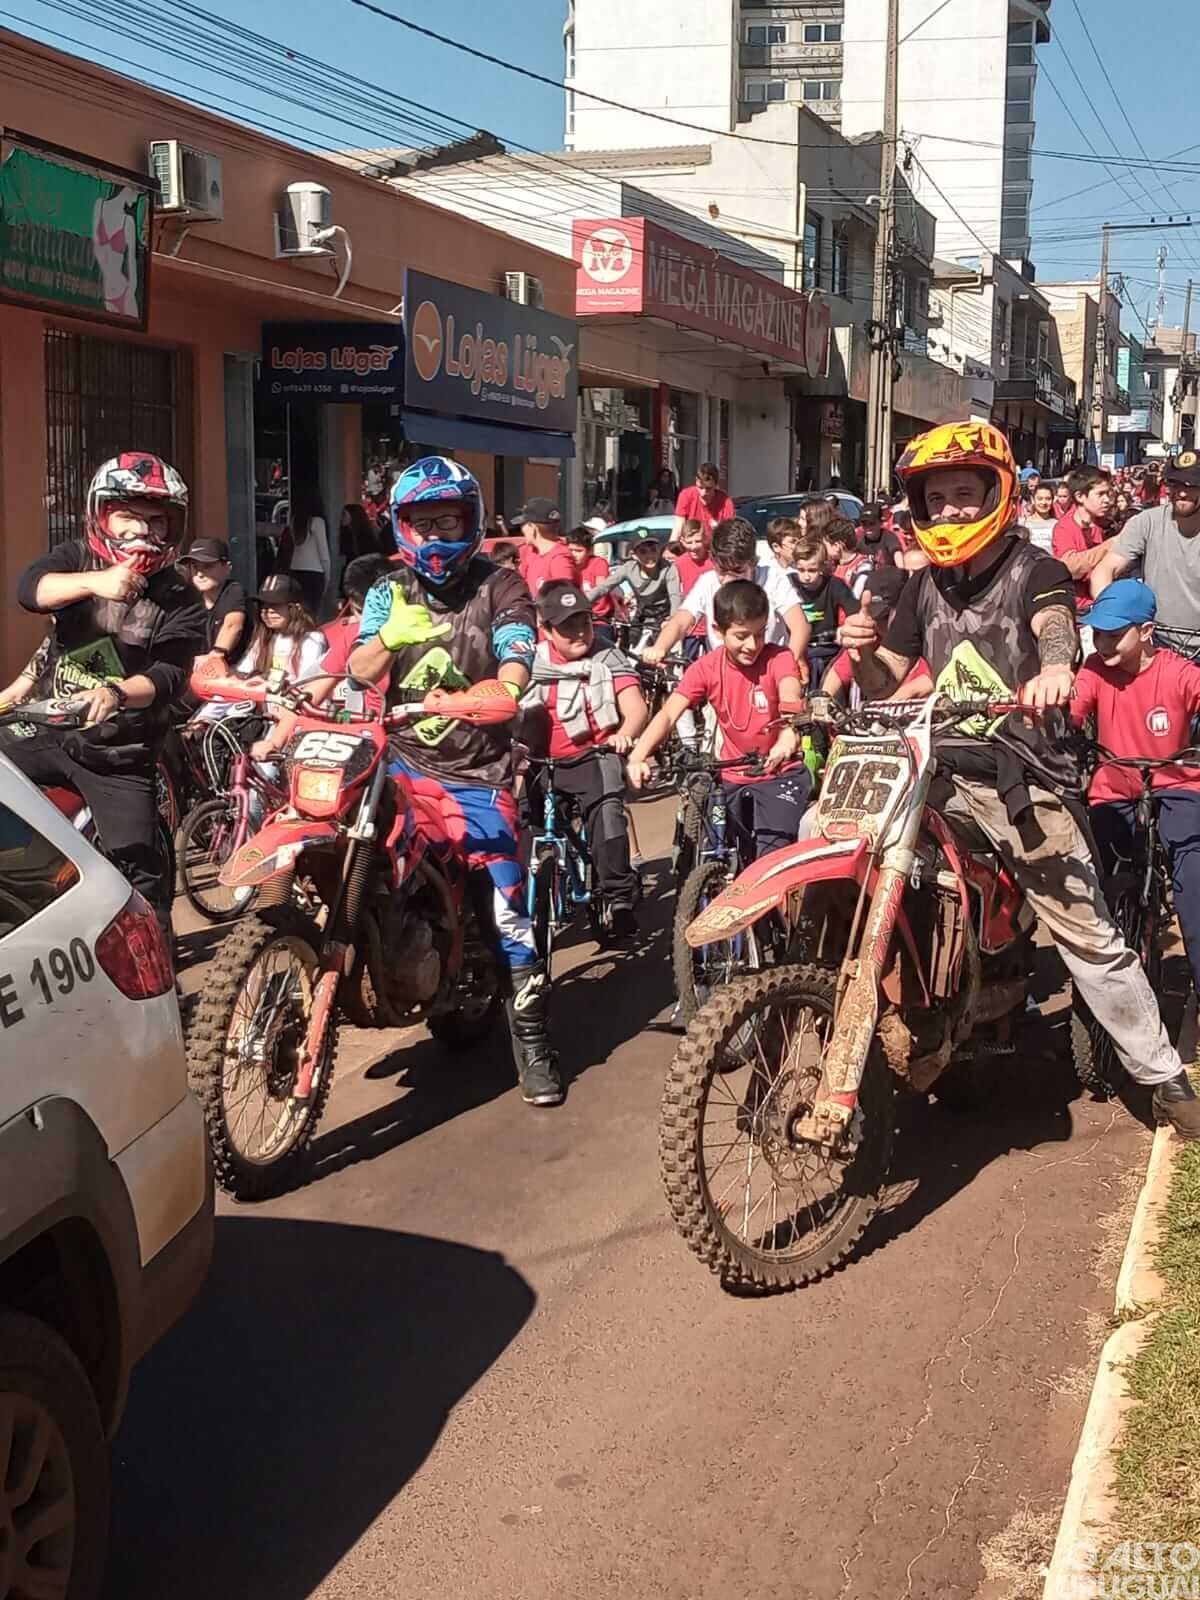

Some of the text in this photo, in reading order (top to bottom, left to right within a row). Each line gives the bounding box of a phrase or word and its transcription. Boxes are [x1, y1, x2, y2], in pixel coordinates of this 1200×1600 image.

[648, 240, 802, 350] MEGA MAGAZINE
[271, 346, 326, 374] Lojas
[445, 314, 509, 395] Lojas
[820, 761, 901, 815] 96
[30, 937, 95, 1005] 190
